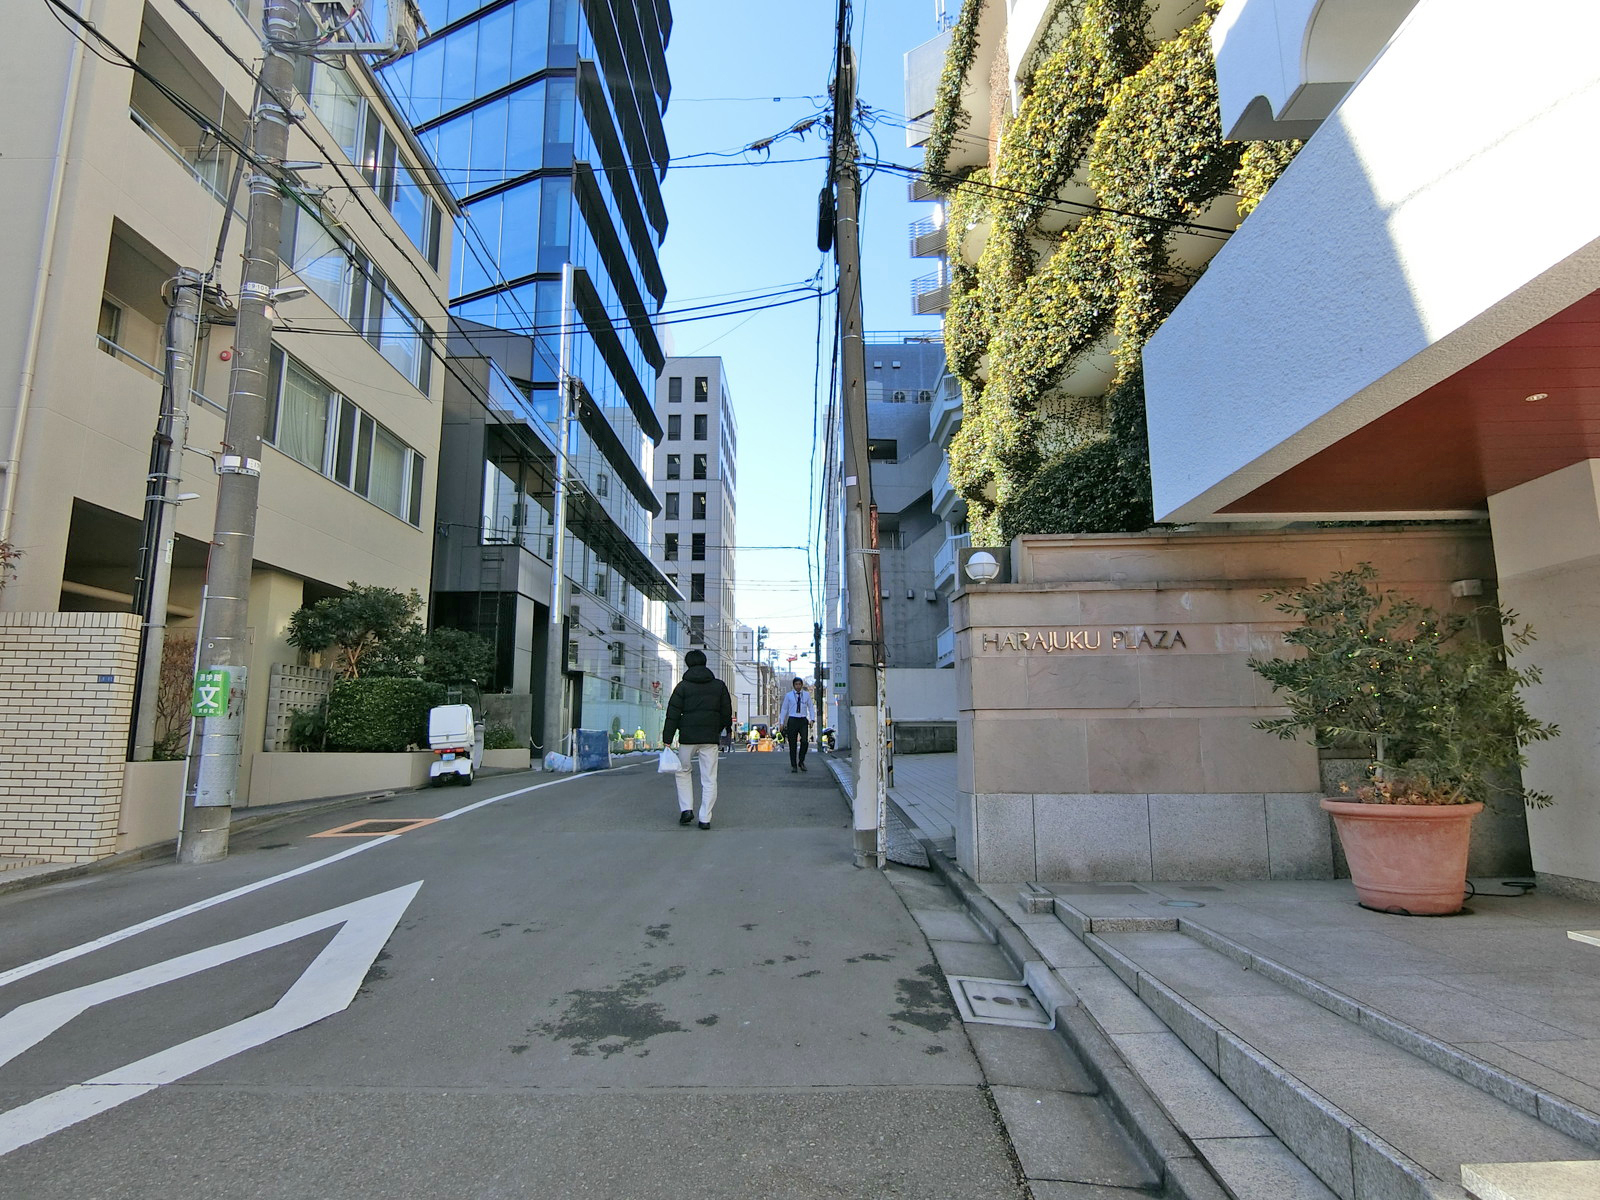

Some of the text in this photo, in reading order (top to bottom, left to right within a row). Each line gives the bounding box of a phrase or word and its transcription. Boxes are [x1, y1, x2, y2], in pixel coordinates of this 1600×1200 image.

[983, 630, 1187, 653] HARAJUKU PLAZA
[197, 683, 221, 708] 文
